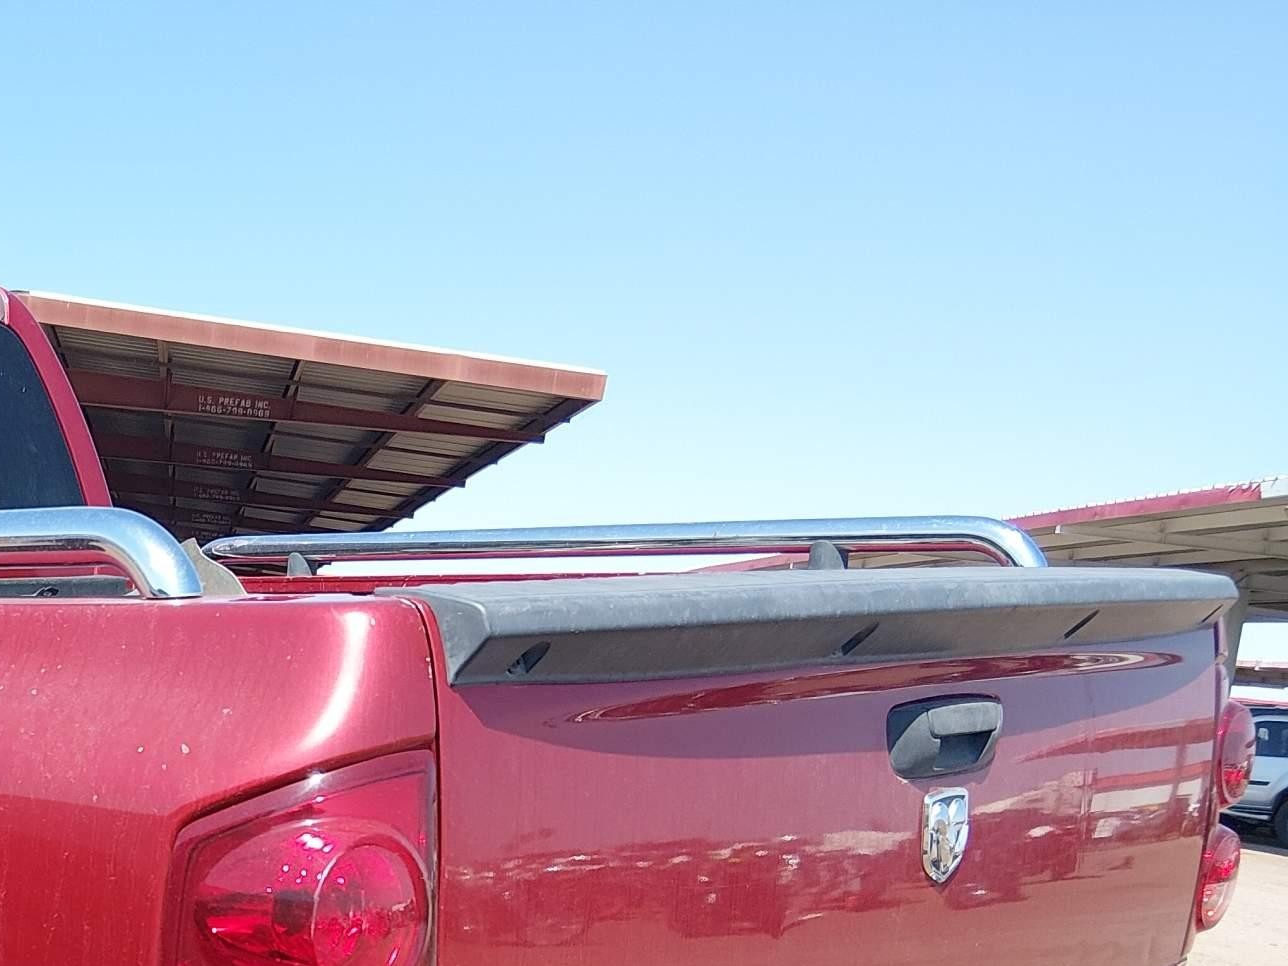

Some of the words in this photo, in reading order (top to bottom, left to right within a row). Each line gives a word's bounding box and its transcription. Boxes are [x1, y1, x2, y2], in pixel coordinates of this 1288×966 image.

[198, 394, 214, 404] U.S.
[218, 396, 252, 408] PREFAB
[255, 399, 271, 410] INC.
